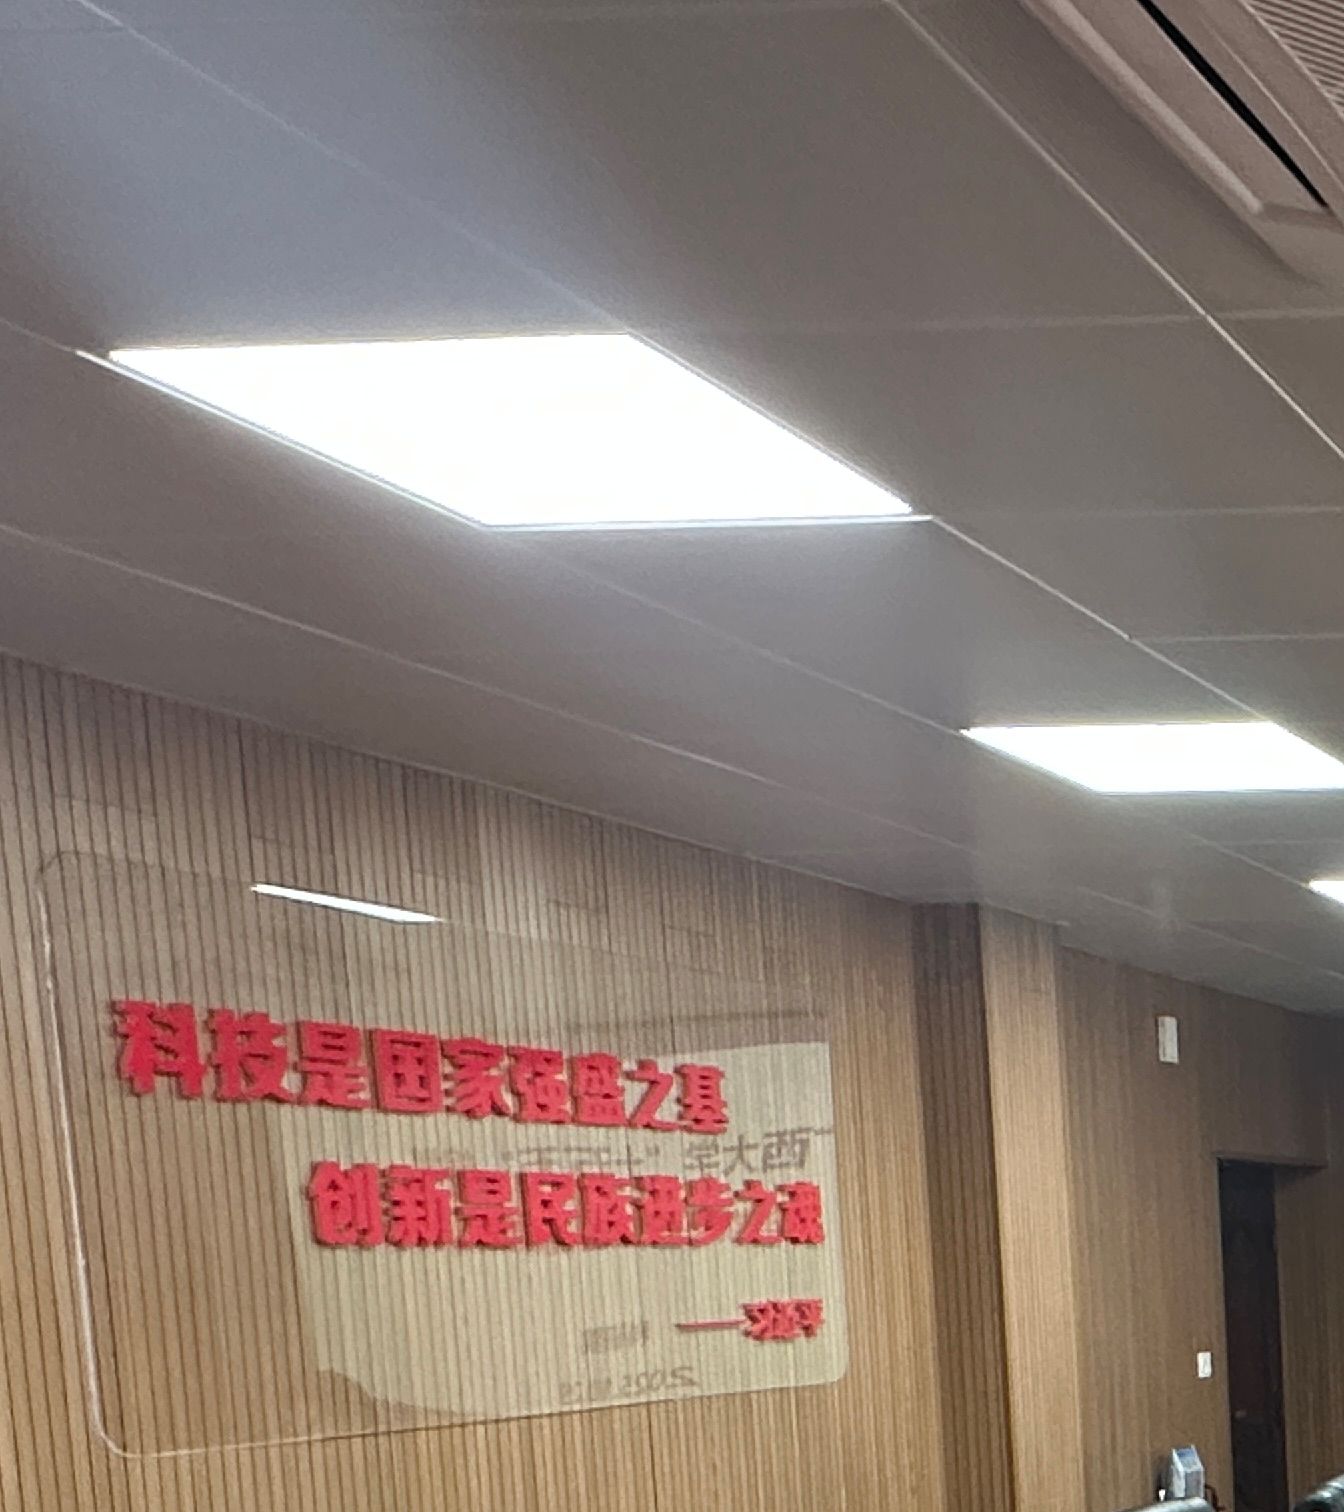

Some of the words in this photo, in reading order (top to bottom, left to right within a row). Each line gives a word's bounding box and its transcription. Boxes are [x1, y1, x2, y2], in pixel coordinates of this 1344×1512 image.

[112, 999, 727, 1134] 科技是国家强盛之基
